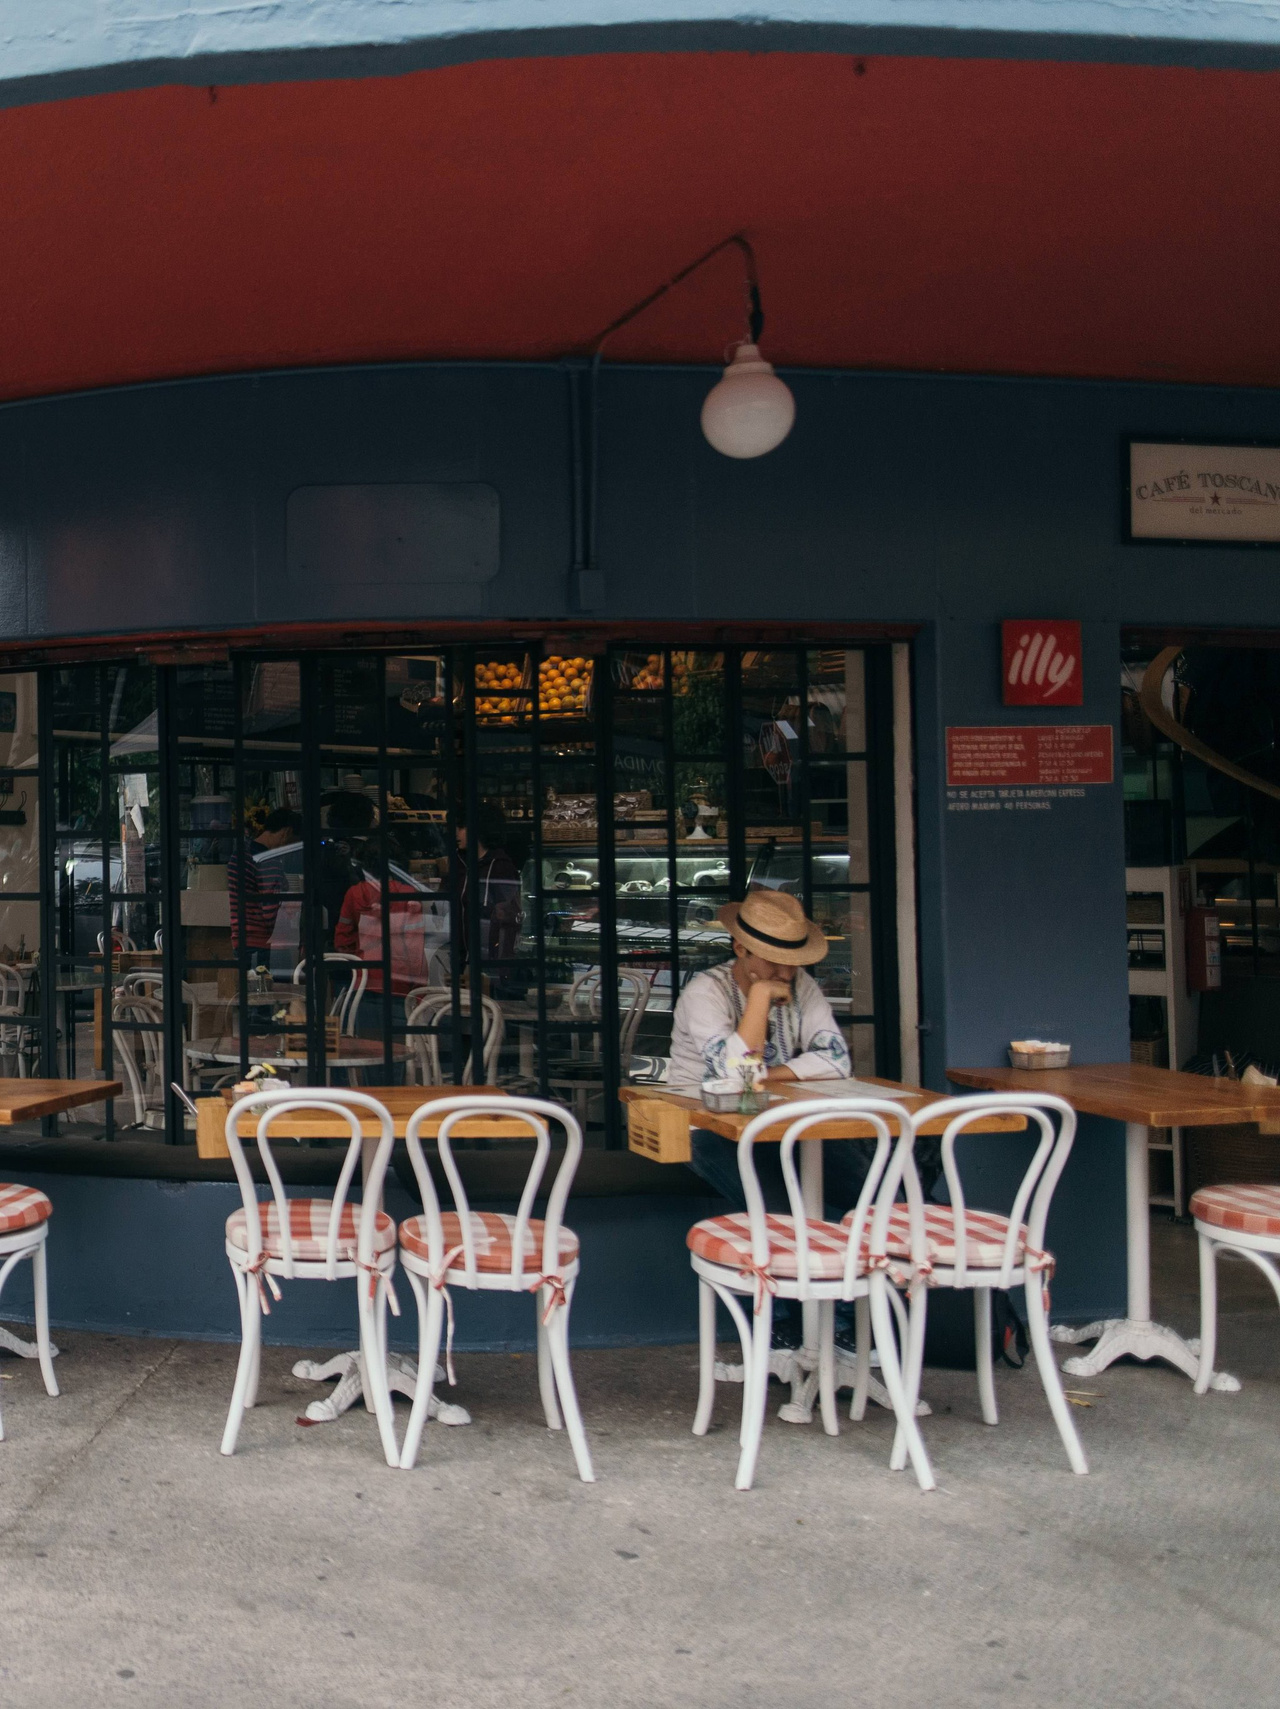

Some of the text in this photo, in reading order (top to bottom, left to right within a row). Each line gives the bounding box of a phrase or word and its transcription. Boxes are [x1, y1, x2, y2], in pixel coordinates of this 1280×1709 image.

[1136, 470, 1191, 500] CAFÉ
[1189, 506, 1242, 515] del mercado
[1007, 632, 1076, 698] illy
